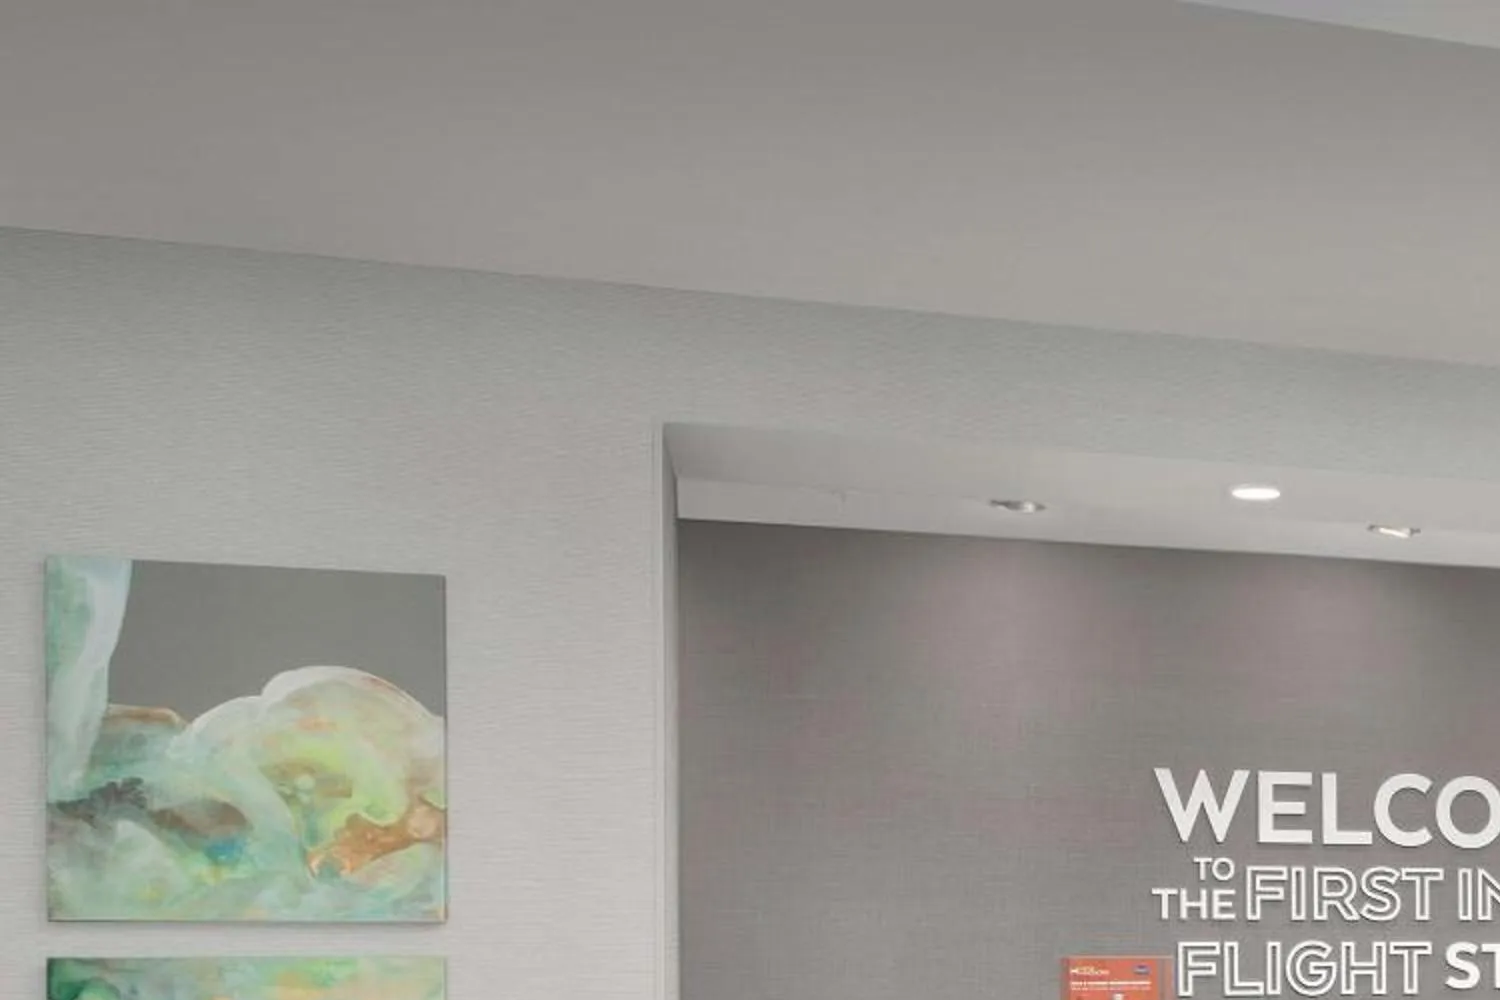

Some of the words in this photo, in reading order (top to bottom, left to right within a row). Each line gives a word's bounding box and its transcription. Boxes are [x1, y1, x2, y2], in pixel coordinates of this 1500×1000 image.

[1152, 888, 1236, 919] THE
[1246, 865, 1444, 921] FIRST
[1193, 855, 1235, 881] TO
[1177, 940, 1433, 997] FLIGHT
